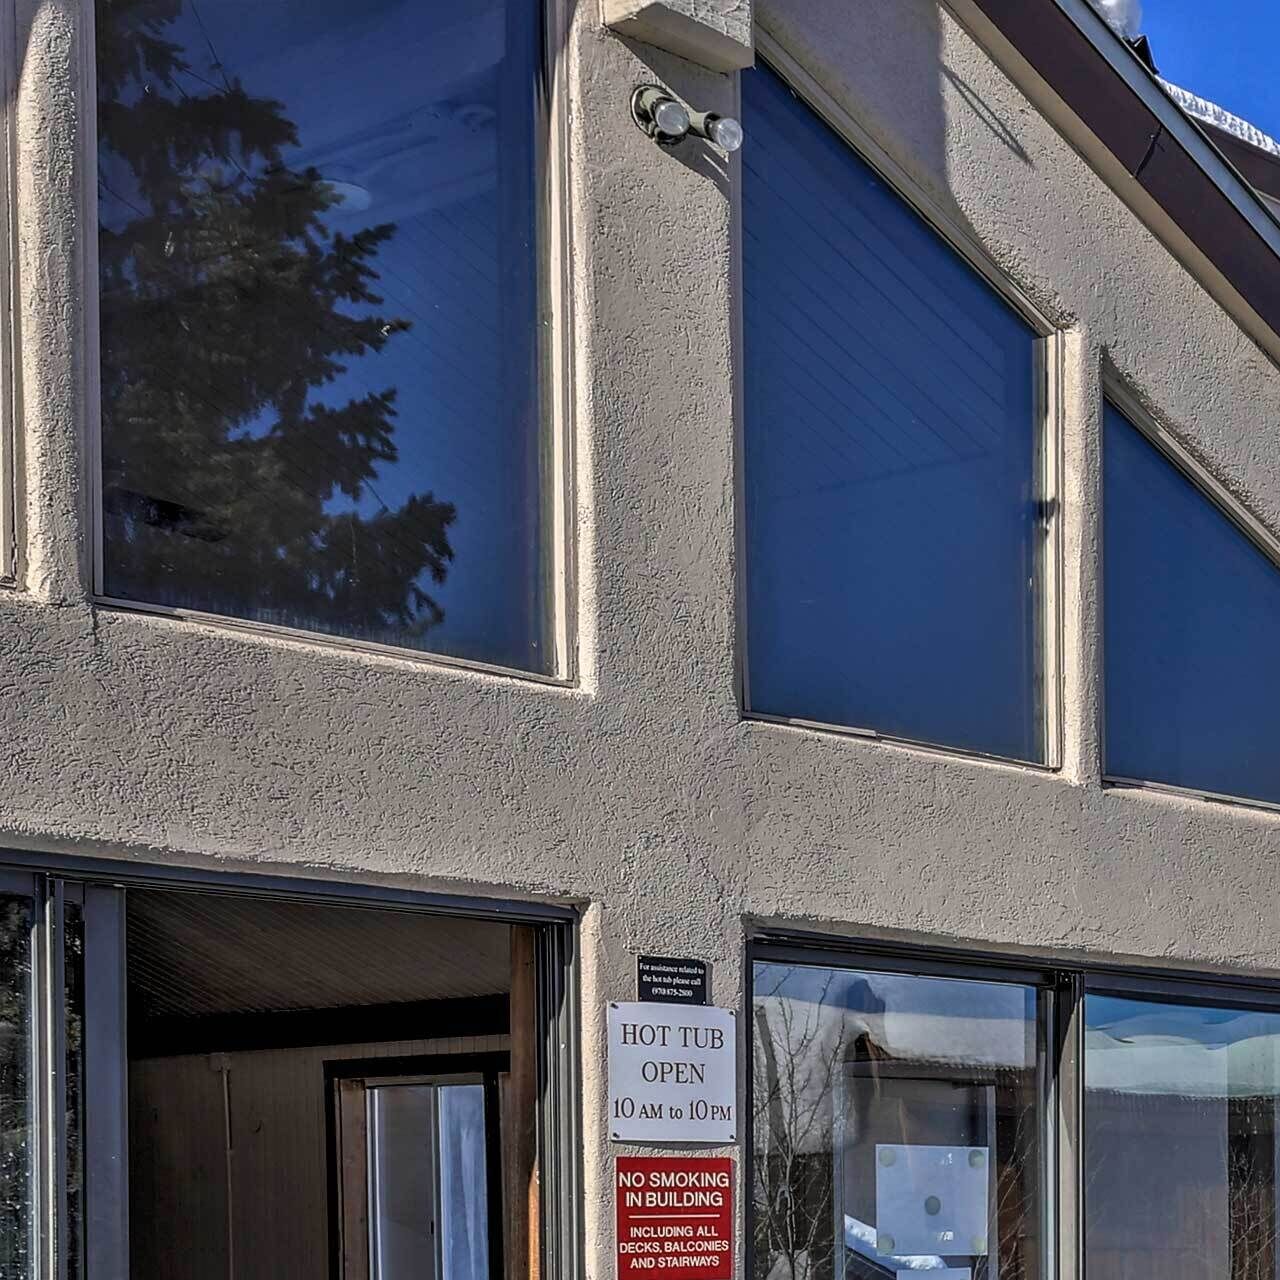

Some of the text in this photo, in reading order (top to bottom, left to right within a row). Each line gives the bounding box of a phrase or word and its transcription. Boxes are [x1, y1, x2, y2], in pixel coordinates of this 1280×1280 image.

[673, 977, 690, 985] please
[621, 1023, 724, 1049] HOT TUB
[642, 1062, 705, 1083] OPEN
[613, 1097, 731, 1121] 10 AM to 10 PM
[619, 1172, 730, 1188] NO SMOKING
[626, 1192, 723, 1207] IN BUILDING
[630, 1226, 719, 1239] INCLUDING ALL
[620, 1240, 729, 1254] DECKS, BALCONIES
[630, 1255, 720, 1268] AND STAIRWAYS
